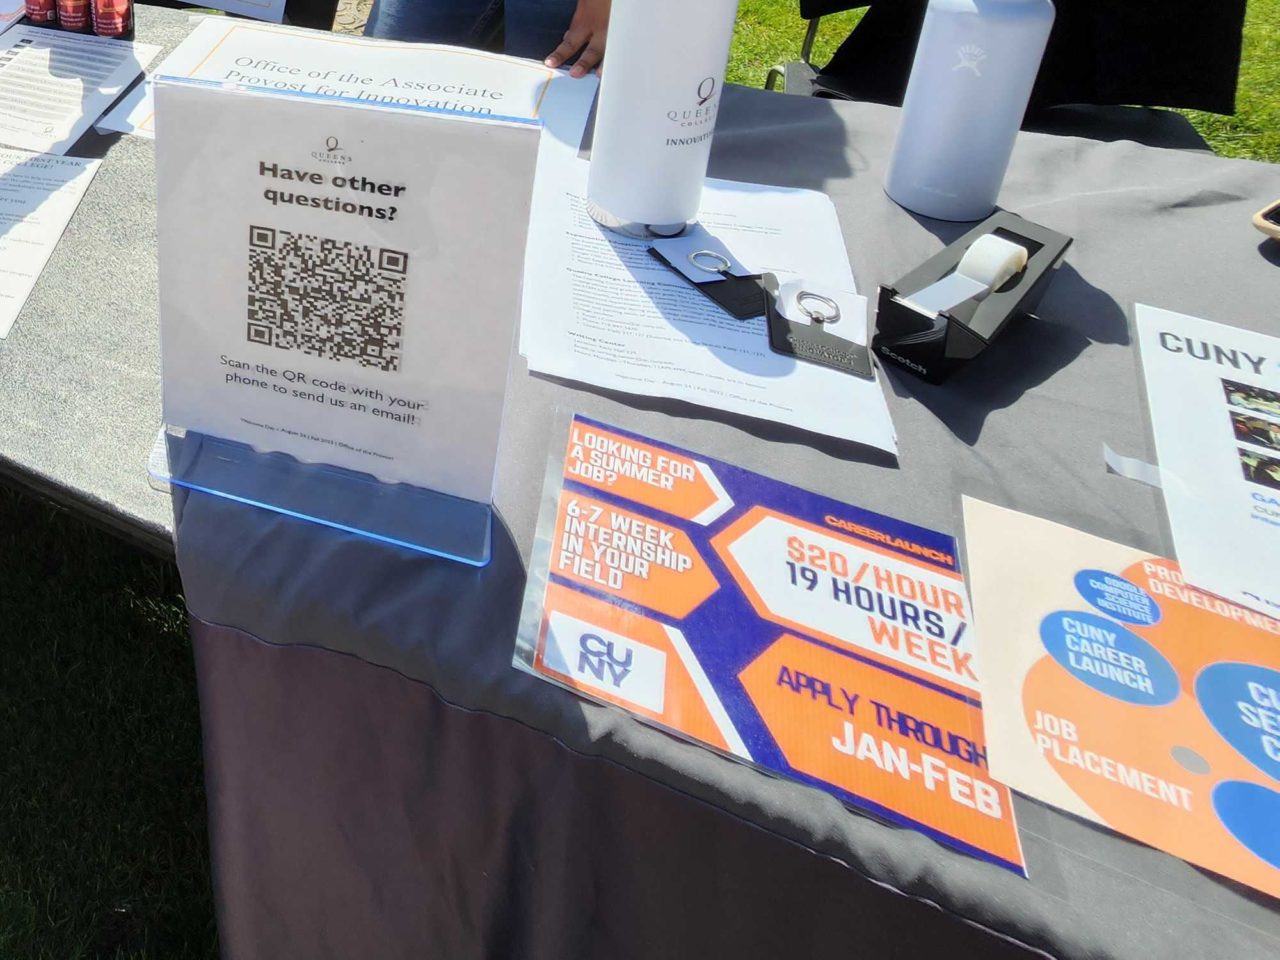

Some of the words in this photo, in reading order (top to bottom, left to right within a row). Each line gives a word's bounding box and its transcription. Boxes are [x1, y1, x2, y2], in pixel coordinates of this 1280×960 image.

[224, 70, 305, 92] Provost
[314, 84, 350, 98] for
[357, 90, 493, 115] Innovation
[234, 56, 301, 75] Office
[308, 70, 337, 81] of
[340, 73, 373, 86] the
[379, 77, 504, 101] Associate
[667, 105, 716, 122] QUEE
[55, 158, 82, 168] YEAR
[311, 152, 352, 162] QUEENS
[259, 161, 323, 185] Have
[332, 176, 406, 198] other
[263, 189, 398, 222] questions?
[881, 346, 928, 375] Scotch
[1159, 331, 1267, 375] CUNY
[220, 355, 250, 371] Scan
[256, 364, 278, 377] the
[283, 370, 307, 384] QR
[312, 378, 346, 393] code
[351, 386, 384, 401] with
[388, 395, 424, 411] your
[225, 372, 268, 389] phone
[273, 383, 287, 394] to
[292, 388, 324, 403] send
[330, 398, 345, 408] us
[350, 402, 366, 413] an
[372, 407, 416, 425] email!
[567, 460, 618, 487] JOB?
[570, 444, 584, 461] A
[590, 449, 674, 491] SUMMER
[571, 428, 652, 468] LOOKING
[657, 455, 696, 482] FOR
[564, 515, 693, 573] INTERNSHIP
[566, 499, 605, 523] 6-7
[610, 511, 675, 550] WEEK
[558, 550, 624, 590] FIELD
[561, 531, 584, 555] IN
[590, 541, 650, 580] YOUR
[785, 560, 819, 592] 19
[786, 535, 966, 619] $20/HOUR
[578, 632, 634, 668] CU
[867, 615, 980, 682] WEEK
[1061, 617, 1117, 648] CUNY
[576, 657, 633, 689] NY
[1065, 634, 1149, 676] CAREER
[1068, 651, 1155, 696] LAUNCH
[776, 665, 860, 717] APPLY
[1034, 710, 1079, 743] JOB
[831, 722, 1003, 820] JAN-FEB
[1036, 732, 1193, 813] PLACEMENT
